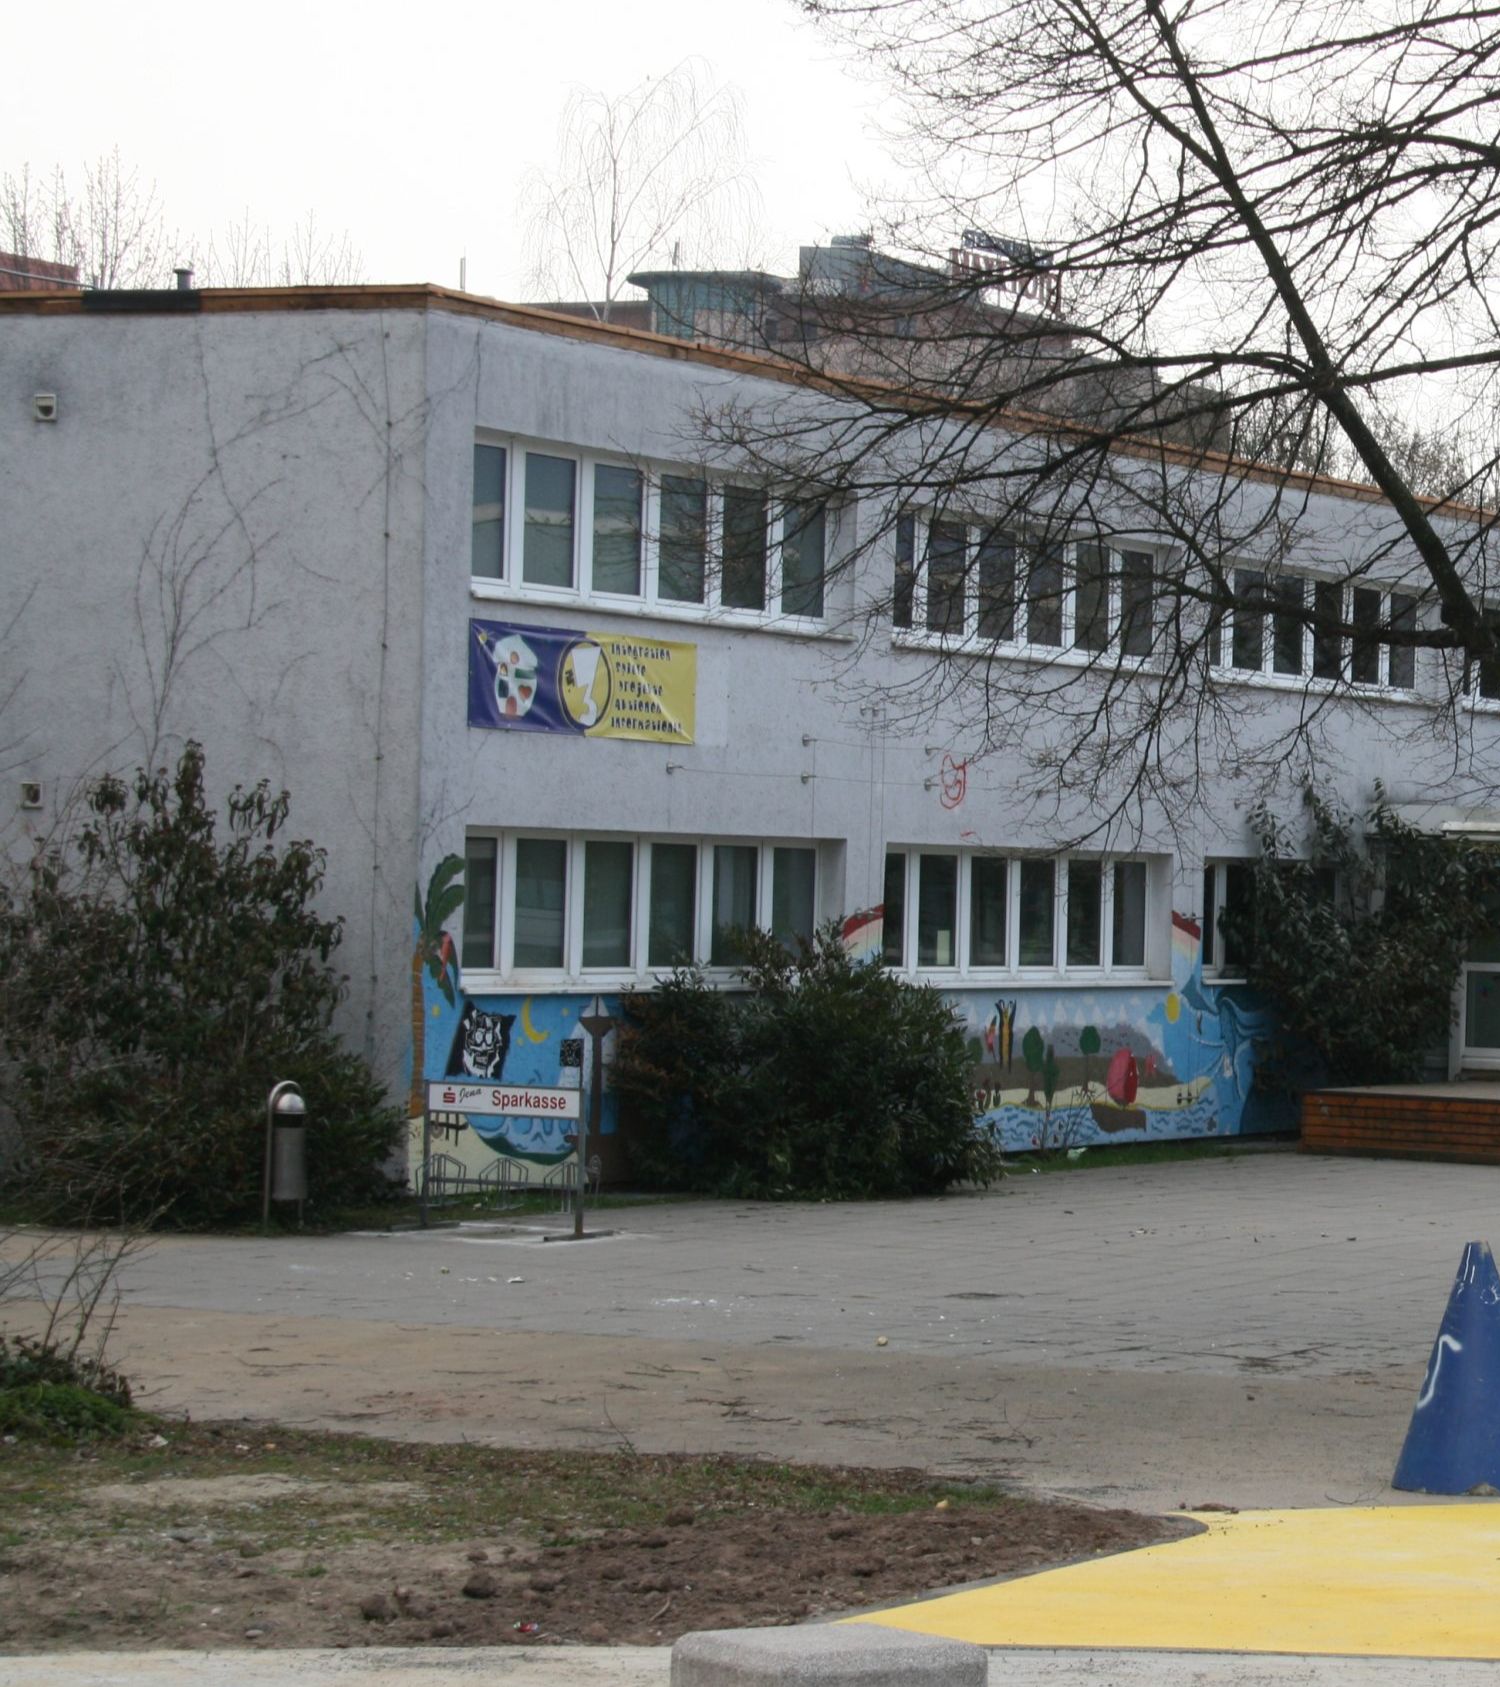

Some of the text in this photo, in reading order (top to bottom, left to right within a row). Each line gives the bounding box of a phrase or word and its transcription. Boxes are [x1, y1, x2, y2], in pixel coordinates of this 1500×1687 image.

[611, 643, 671, 661] Integration
[615, 698, 662, 714] Aktionen
[459, 1087, 482, 1103] Jena
[492, 1090, 566, 1110] Sparkasse
